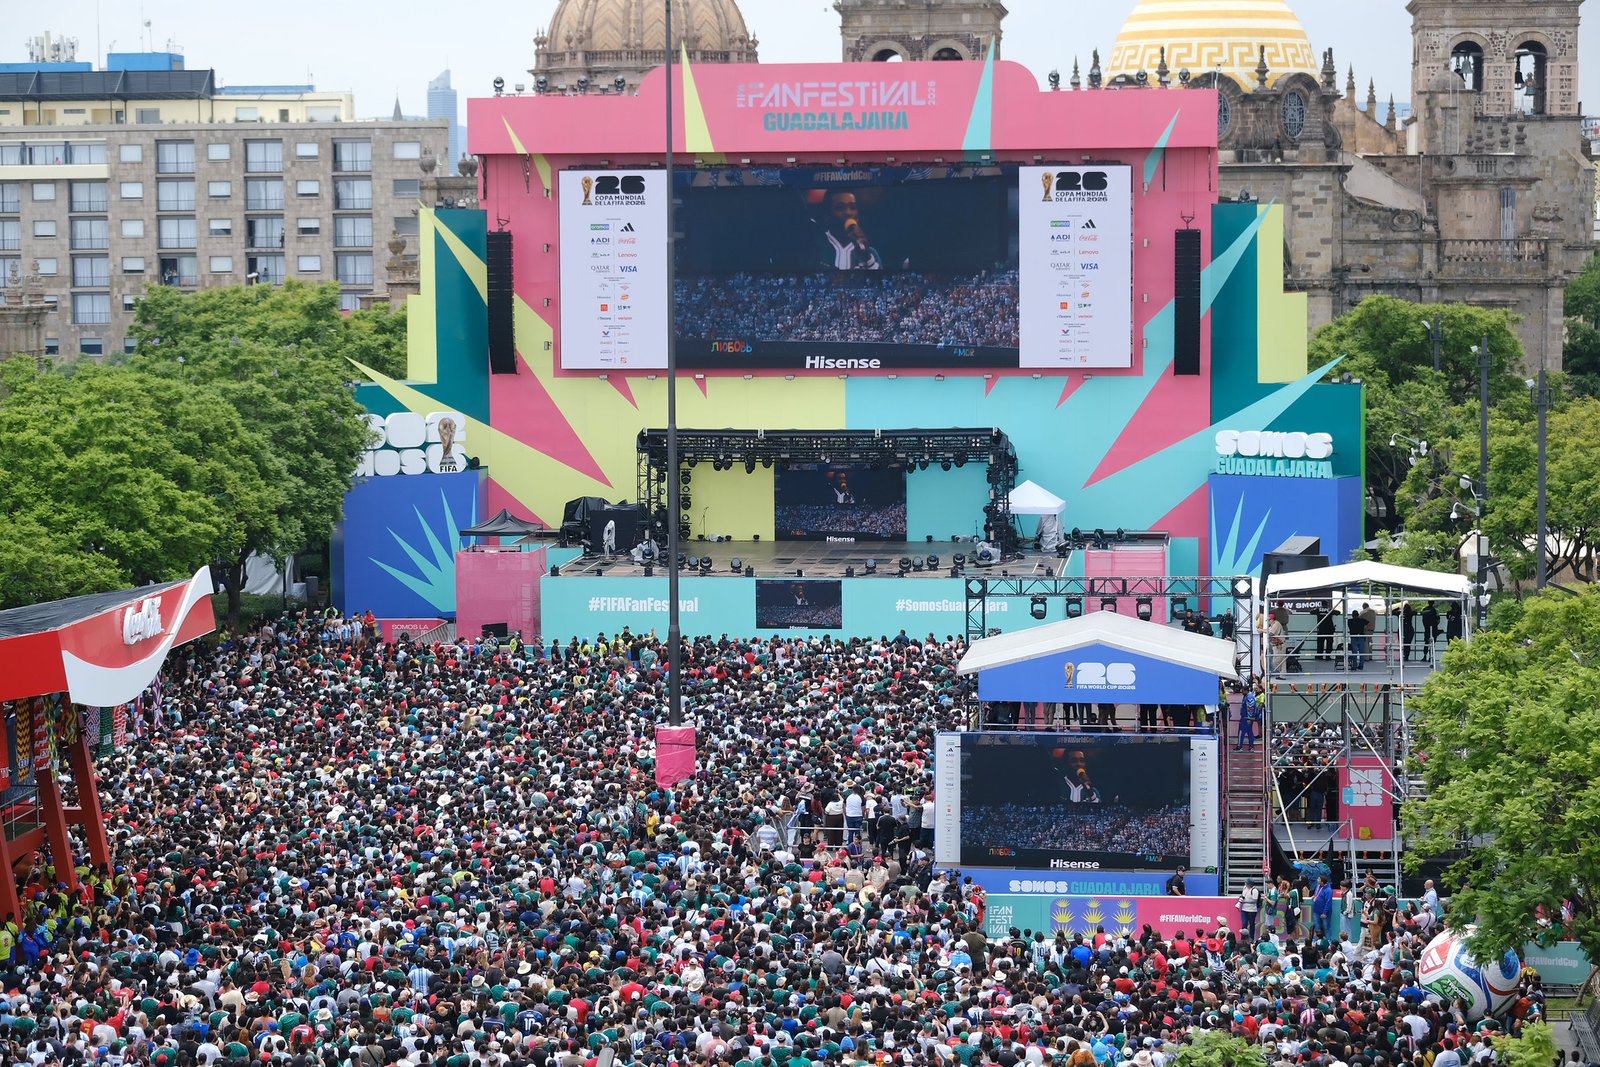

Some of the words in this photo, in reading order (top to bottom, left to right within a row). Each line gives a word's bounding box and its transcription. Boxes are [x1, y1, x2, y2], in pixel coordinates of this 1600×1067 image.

[764, 111, 908, 132] GUADALAJARA
[595, 176, 645, 194] 26
[1056, 172, 1108, 191] 26
[620, 265, 638, 273] VISA
[805, 356, 881, 369] Hisense
[1215, 430, 1333, 459] SOMOS
[1215, 458, 1334, 479] GUADALAJARA
[589, 597, 699, 612] #FIFAFanFesval
[1295, 601, 1322, 609] SMOK
[1076, 662, 1136, 685] 26
[1050, 859, 1100, 869] Hisense
[1009, 880, 1068, 893] SOMOS
[1071, 881, 1161, 895] GUADALAJARA
[1159, 914, 1211, 924] #FIFAWorldCup
